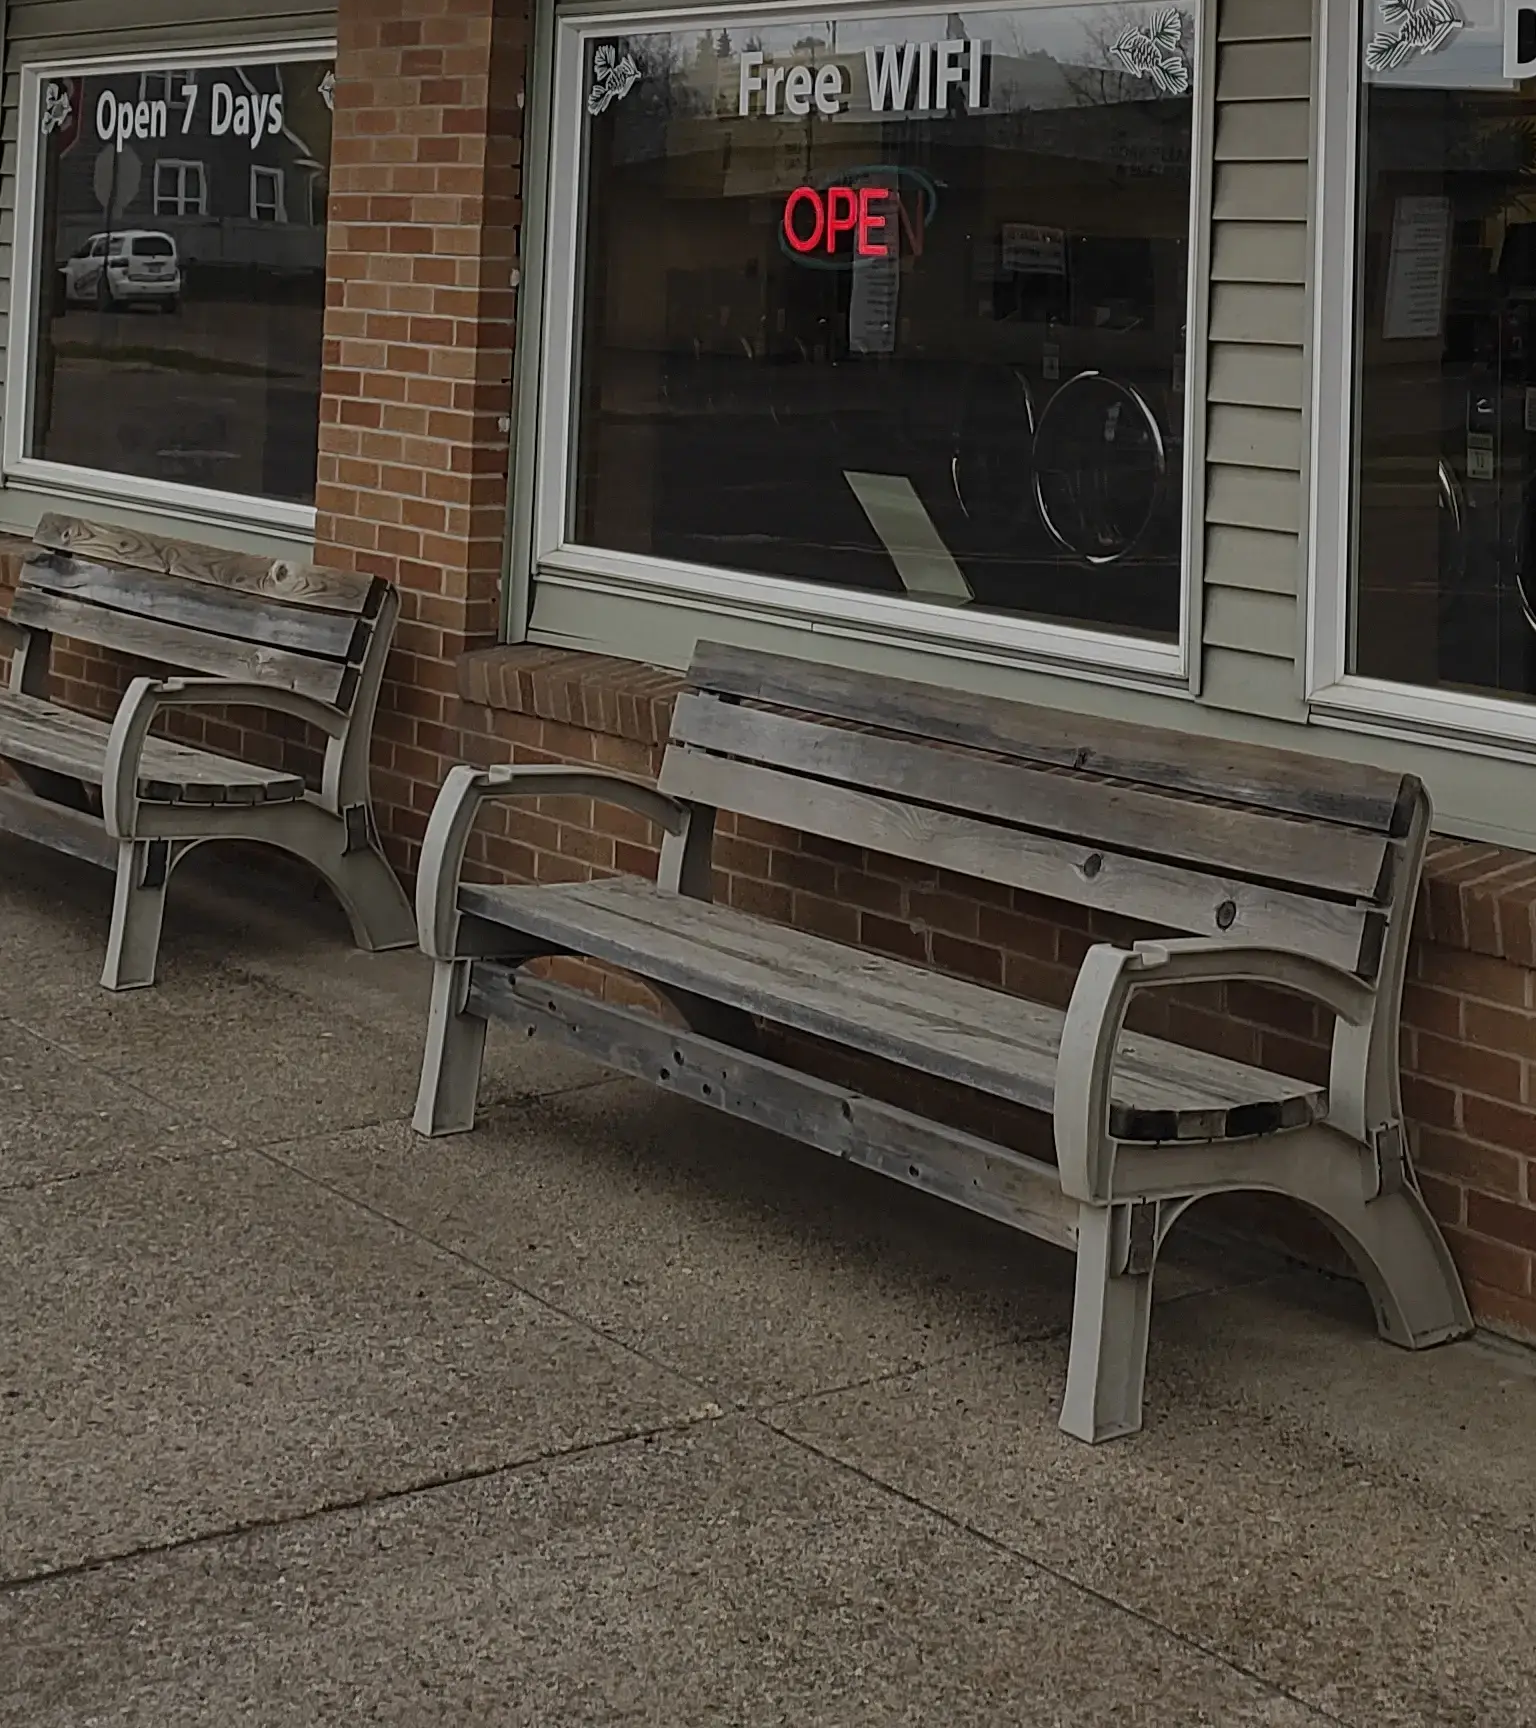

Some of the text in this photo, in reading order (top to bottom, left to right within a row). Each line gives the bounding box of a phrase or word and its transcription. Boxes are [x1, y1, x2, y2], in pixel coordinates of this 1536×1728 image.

[738, 38, 983, 116] Free WIFI
[95, 82, 283, 153] Open 7 Days
